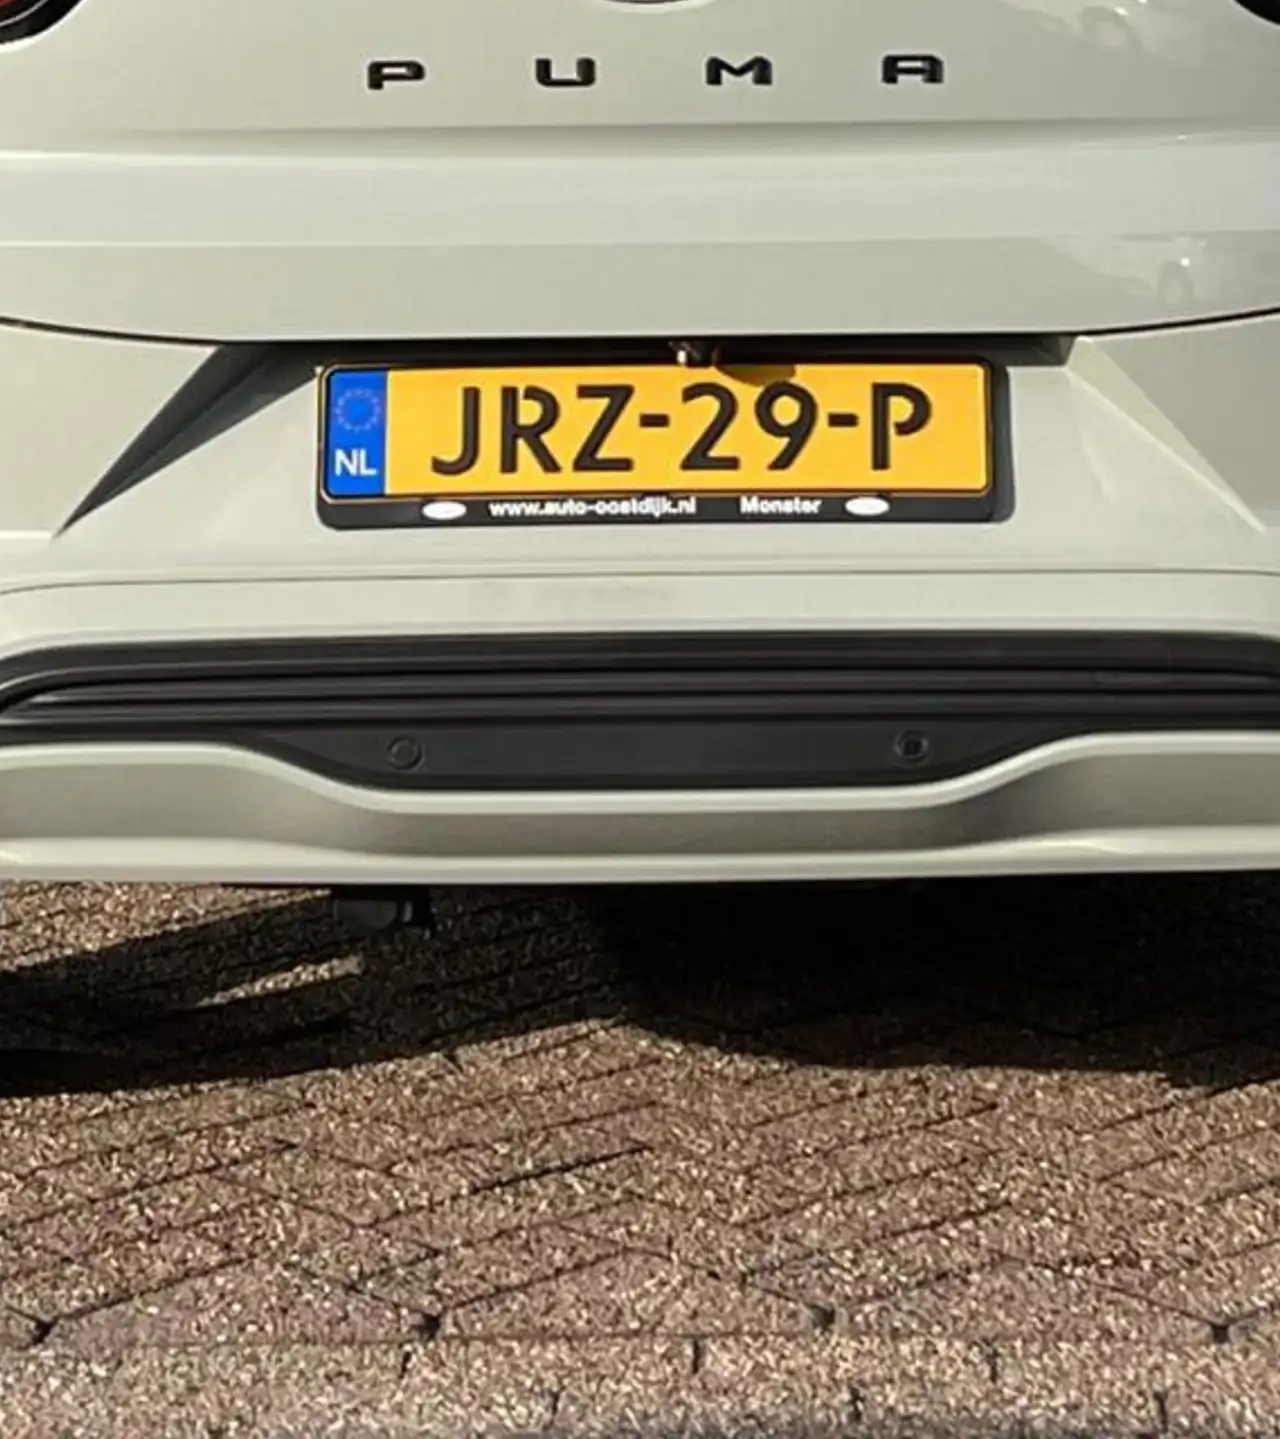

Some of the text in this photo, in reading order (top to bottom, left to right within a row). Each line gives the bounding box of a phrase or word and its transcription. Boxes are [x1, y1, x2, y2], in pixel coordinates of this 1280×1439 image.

[366, 54, 945, 90] PUMA
[430, 380, 934, 477] JRZ-29-P
[333, 449, 377, 477] NL
[488, 495, 822, 518] www.auto-oostdijk.nl Monster
